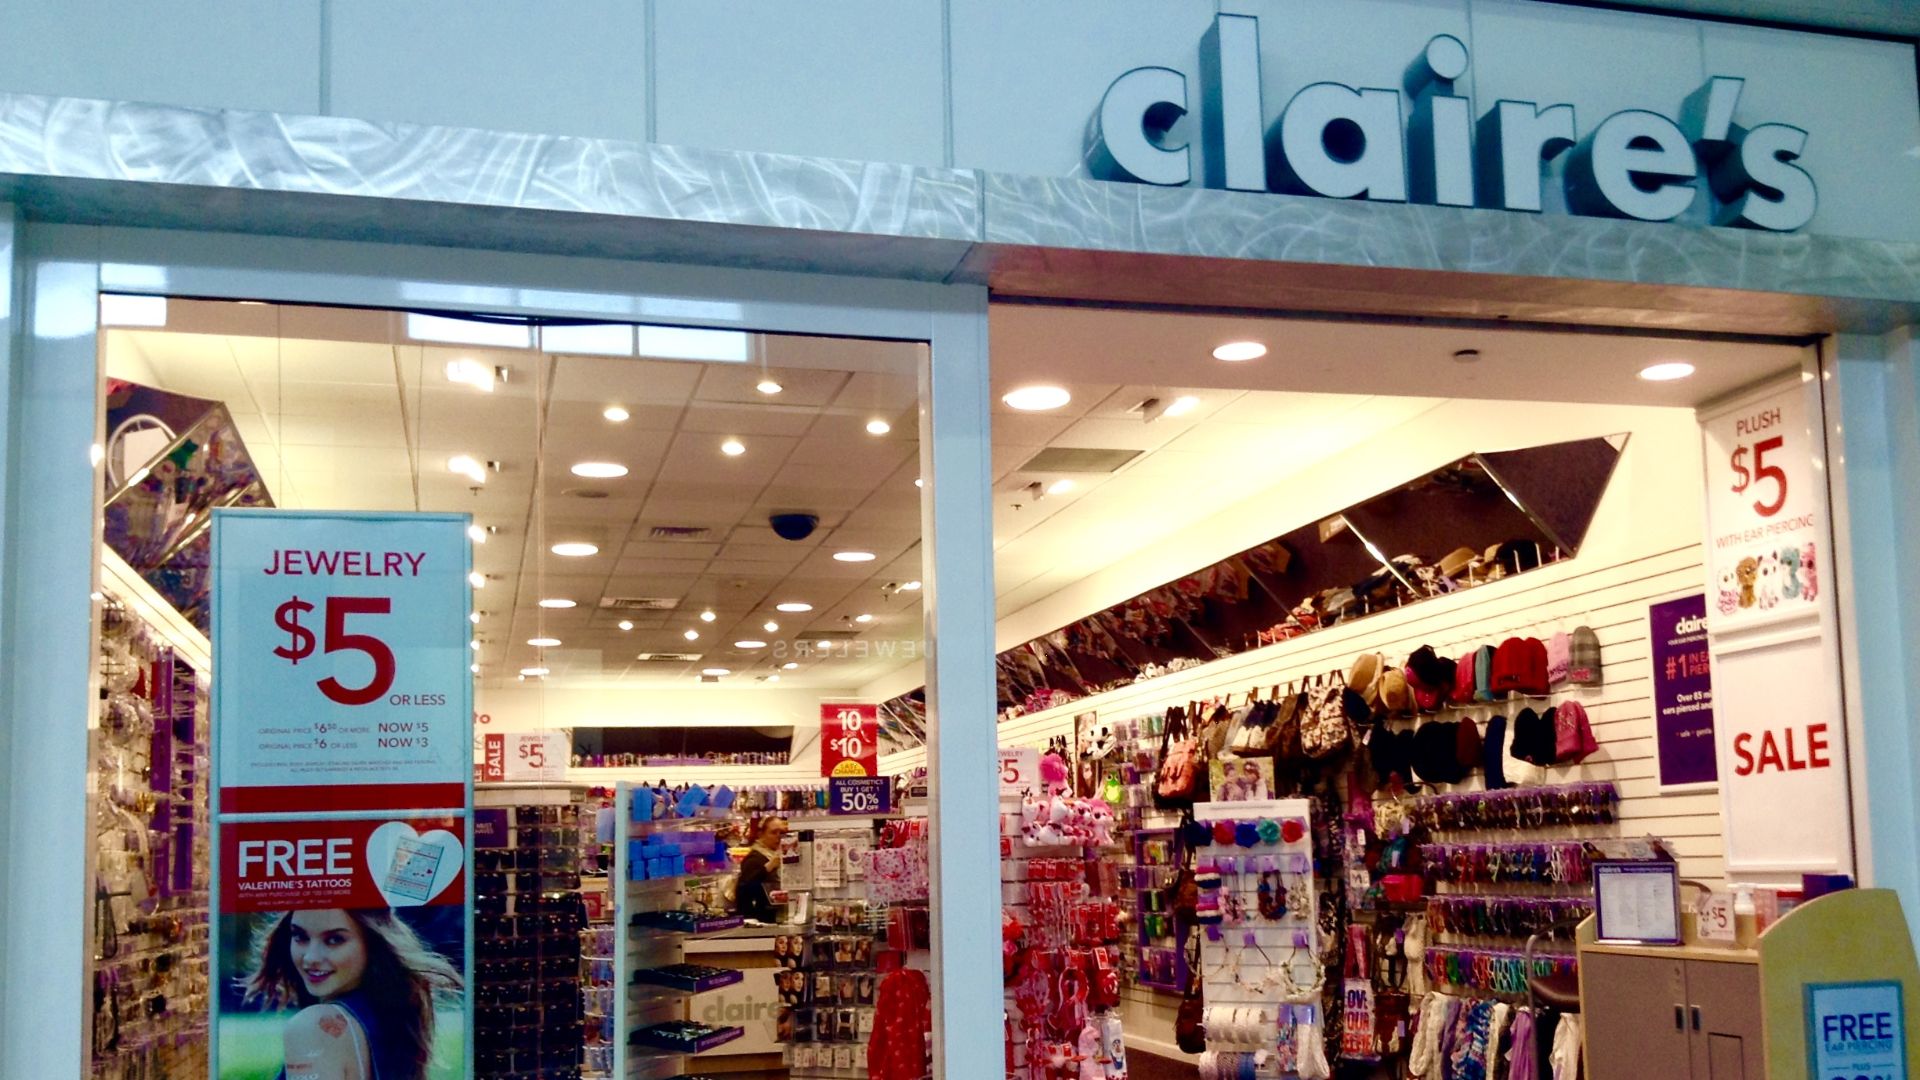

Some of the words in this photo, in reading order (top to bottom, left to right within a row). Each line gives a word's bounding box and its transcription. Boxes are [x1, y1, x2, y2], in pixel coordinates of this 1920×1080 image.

[1095, 13, 1819, 232] claire's
[1736, 407, 1781, 437] PLUSH
[1730, 435, 1787, 517] $5
[1716, 532, 1742, 548] WITH
[1744, 526, 1763, 543] EAR
[264, 550, 426, 577] JEWELRY
[273, 595, 396, 706] $5
[1666, 653, 1687, 680] #1
[389, 694, 411, 707] OR
[414, 694, 446, 707] LESS
[378, 722, 413, 733] NOW
[416, 722, 429, 733] $5
[837, 710, 862, 731] 10
[378, 737, 413, 748] NOW
[416, 738, 429, 748] $3
[519, 743, 544, 768] $5
[830, 737, 862, 758] $10
[1733, 722, 1830, 776] SALE
[488, 740, 501, 777] SALE
[841, 792, 879, 811] 50%
[238, 838, 353, 878] FREE
[238, 880, 304, 891] VALENTINE'S
[306, 878, 352, 889] TATTOOS
[1712, 907, 1728, 928] $5
[1823, 1012, 1894, 1041] FREE
